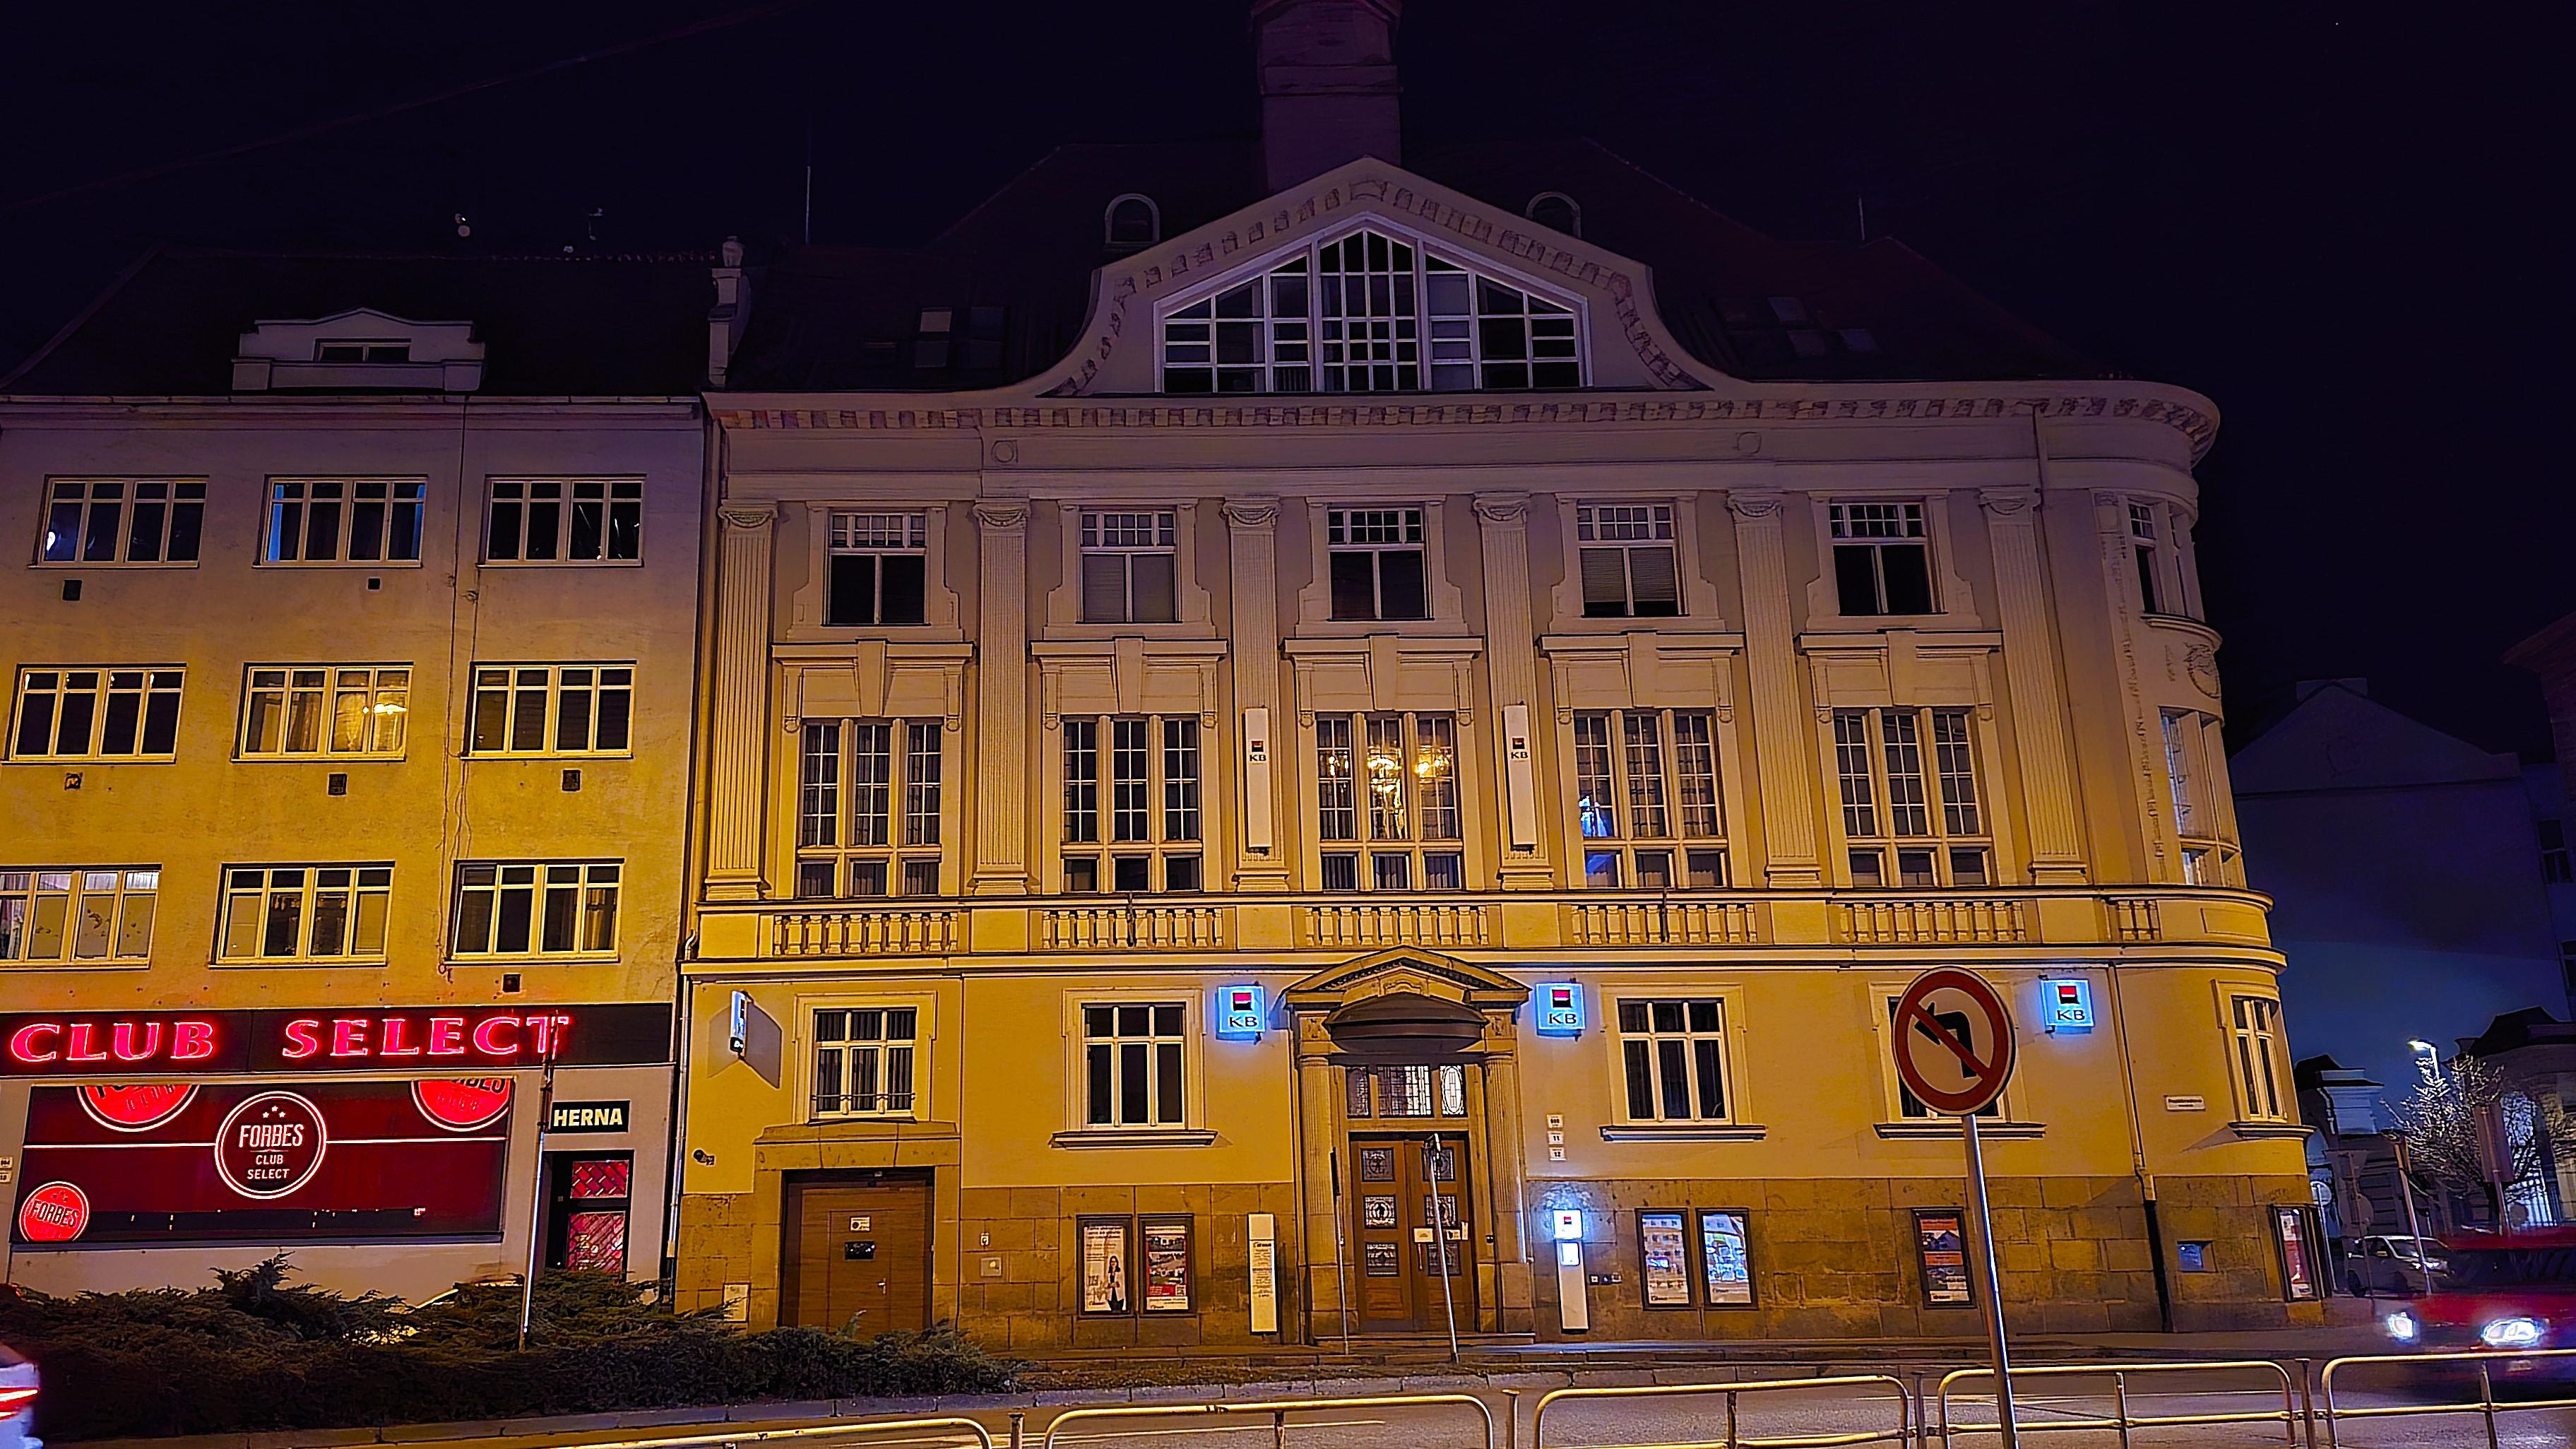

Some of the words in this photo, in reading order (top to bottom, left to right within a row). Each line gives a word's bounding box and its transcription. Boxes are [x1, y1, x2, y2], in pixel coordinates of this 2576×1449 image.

[1229, 1016, 1258, 1027] KB
[1549, 1012, 1577, 1024] KB
[2057, 1010, 2086, 1021] KB
[11, 1022, 213, 1062] CLUB
[282, 1016, 569, 1058] SELECT
[553, 1108, 623, 1127] HERNA
[239, 1123, 305, 1148] FORBES
[255, 1154, 284, 1166] CLUB
[247, 1168, 291, 1180] SELECT
[28, 1198, 81, 1228] FORBES
